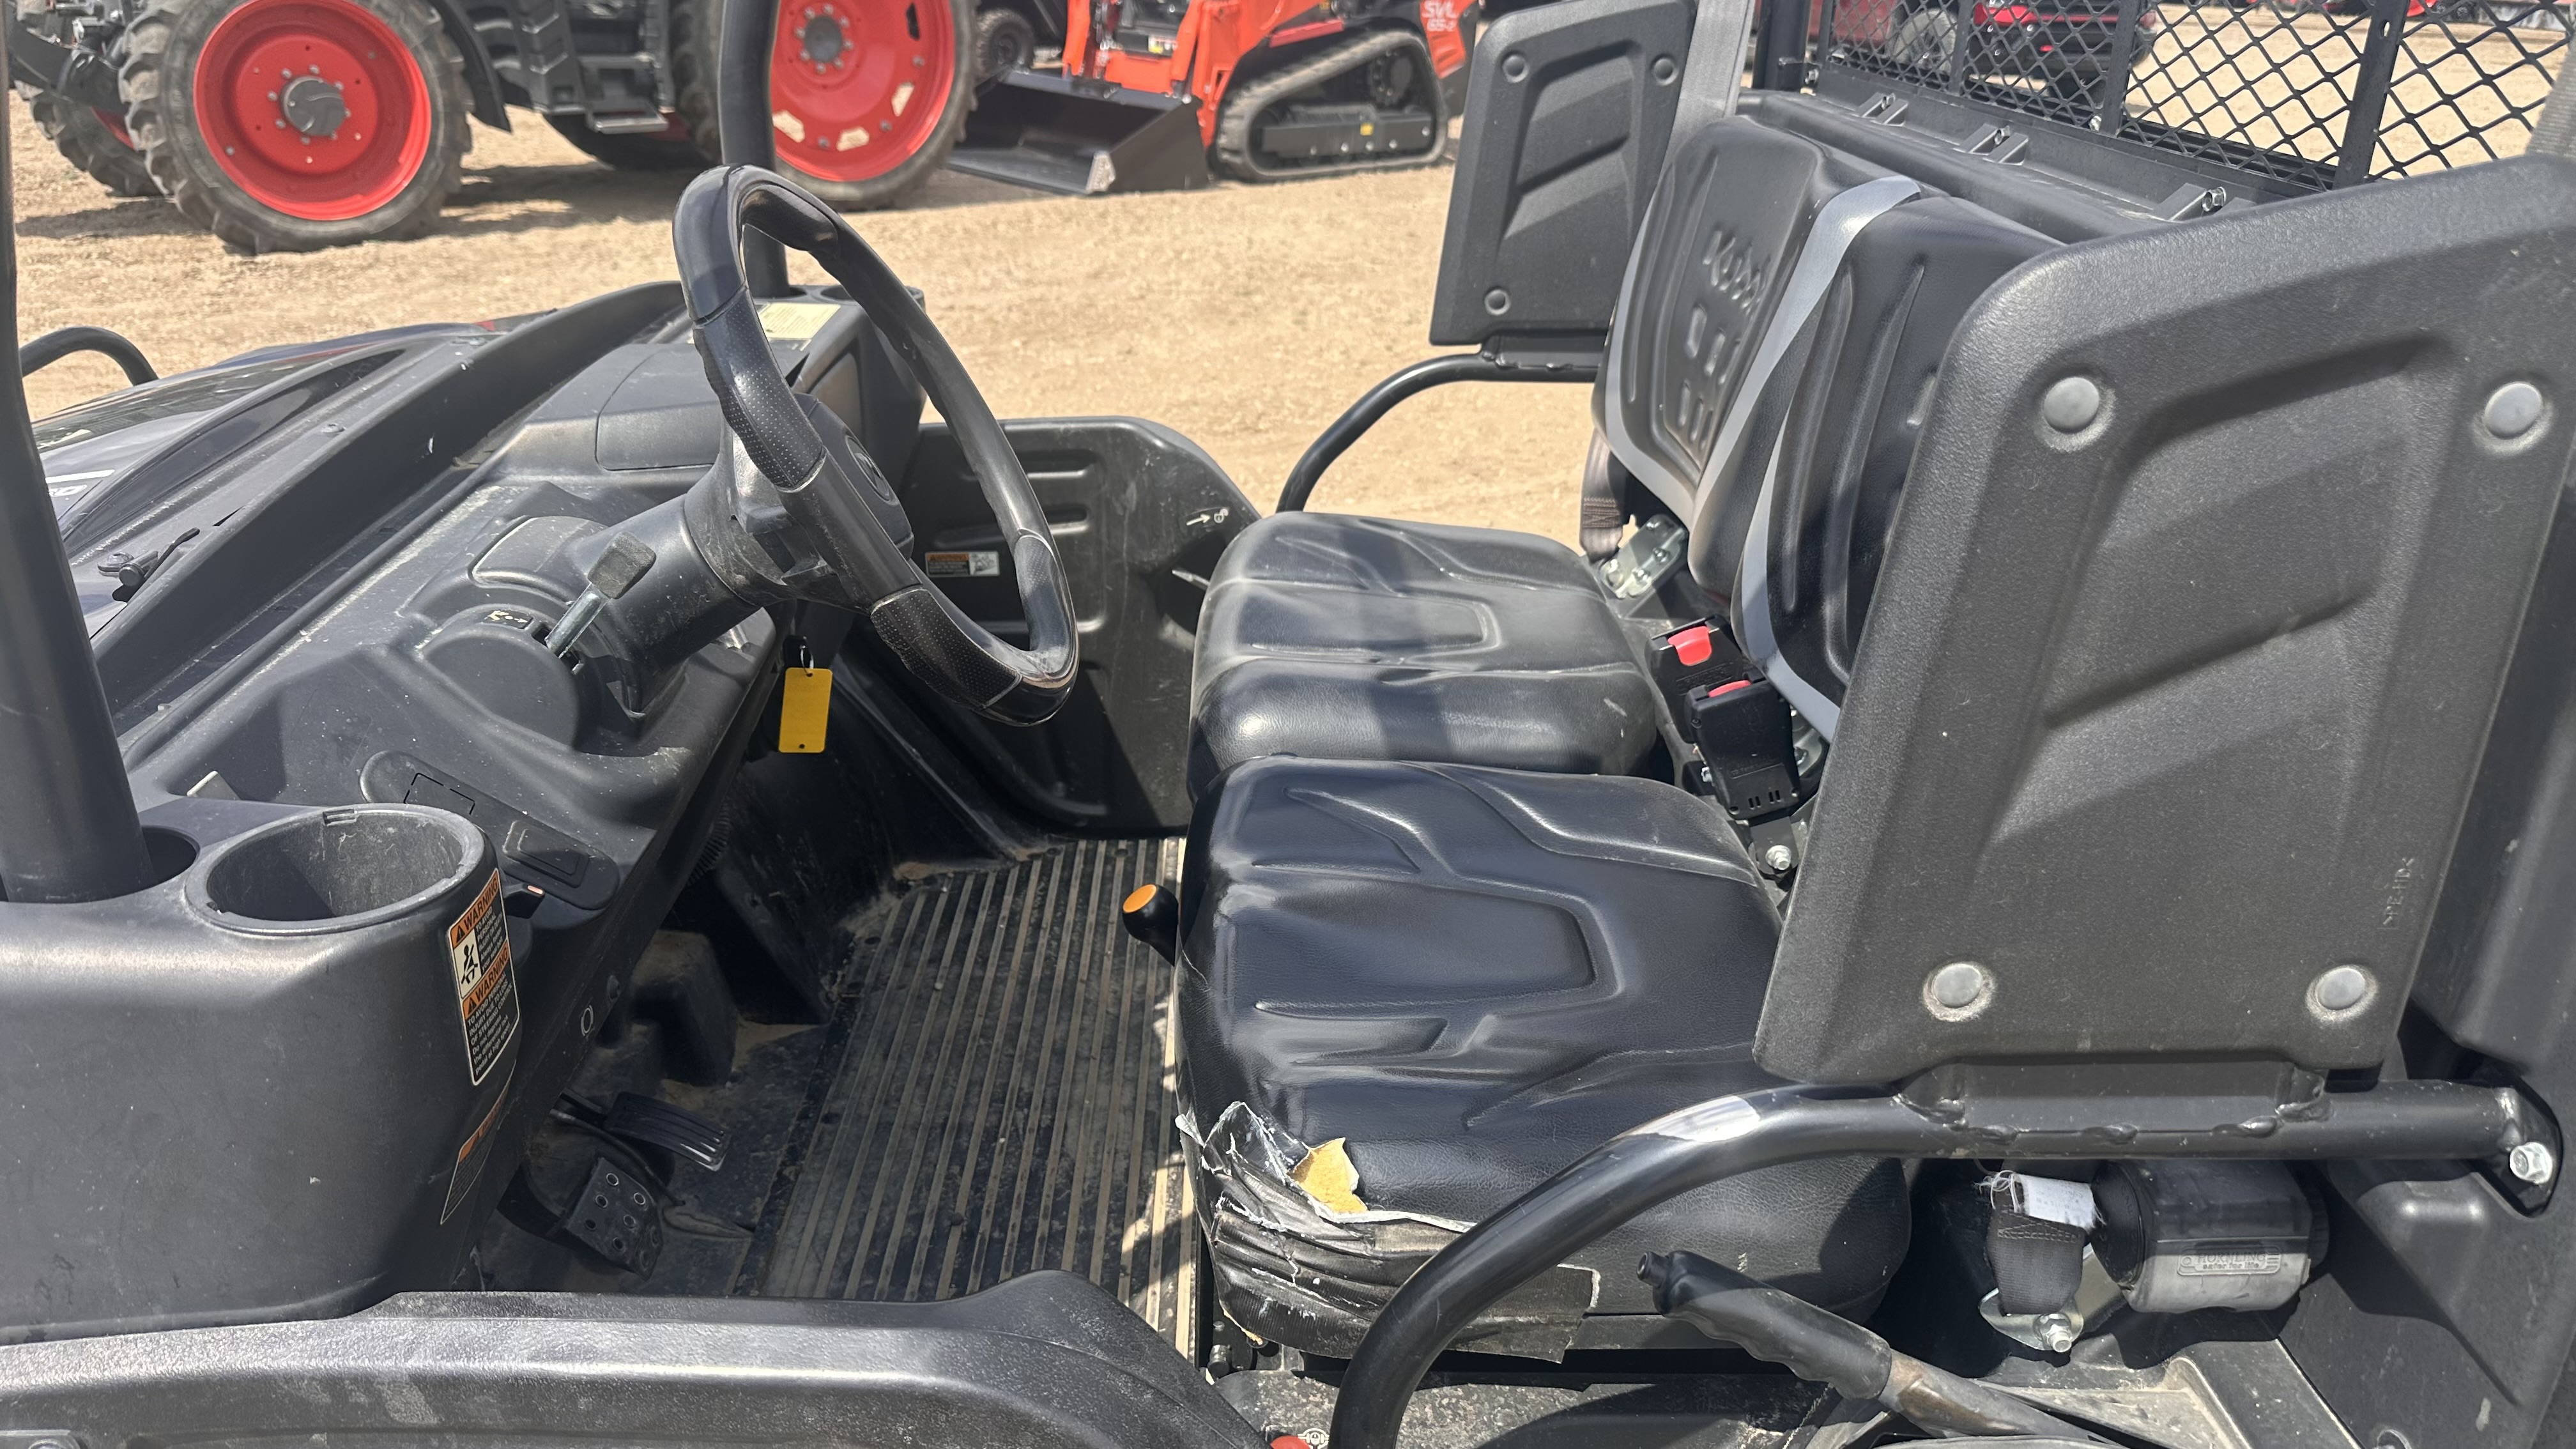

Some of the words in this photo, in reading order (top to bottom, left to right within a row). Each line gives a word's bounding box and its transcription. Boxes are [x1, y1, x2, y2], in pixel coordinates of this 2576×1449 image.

[1422, 0, 1459, 18] SVL
[463, 878, 498, 931] WARNING
[475, 947, 508, 1002] WARNING
[467, 1015, 475, 1027] TO
[475, 998, 489, 1018] AVOID
[470, 1032, 479, 1046] OF
